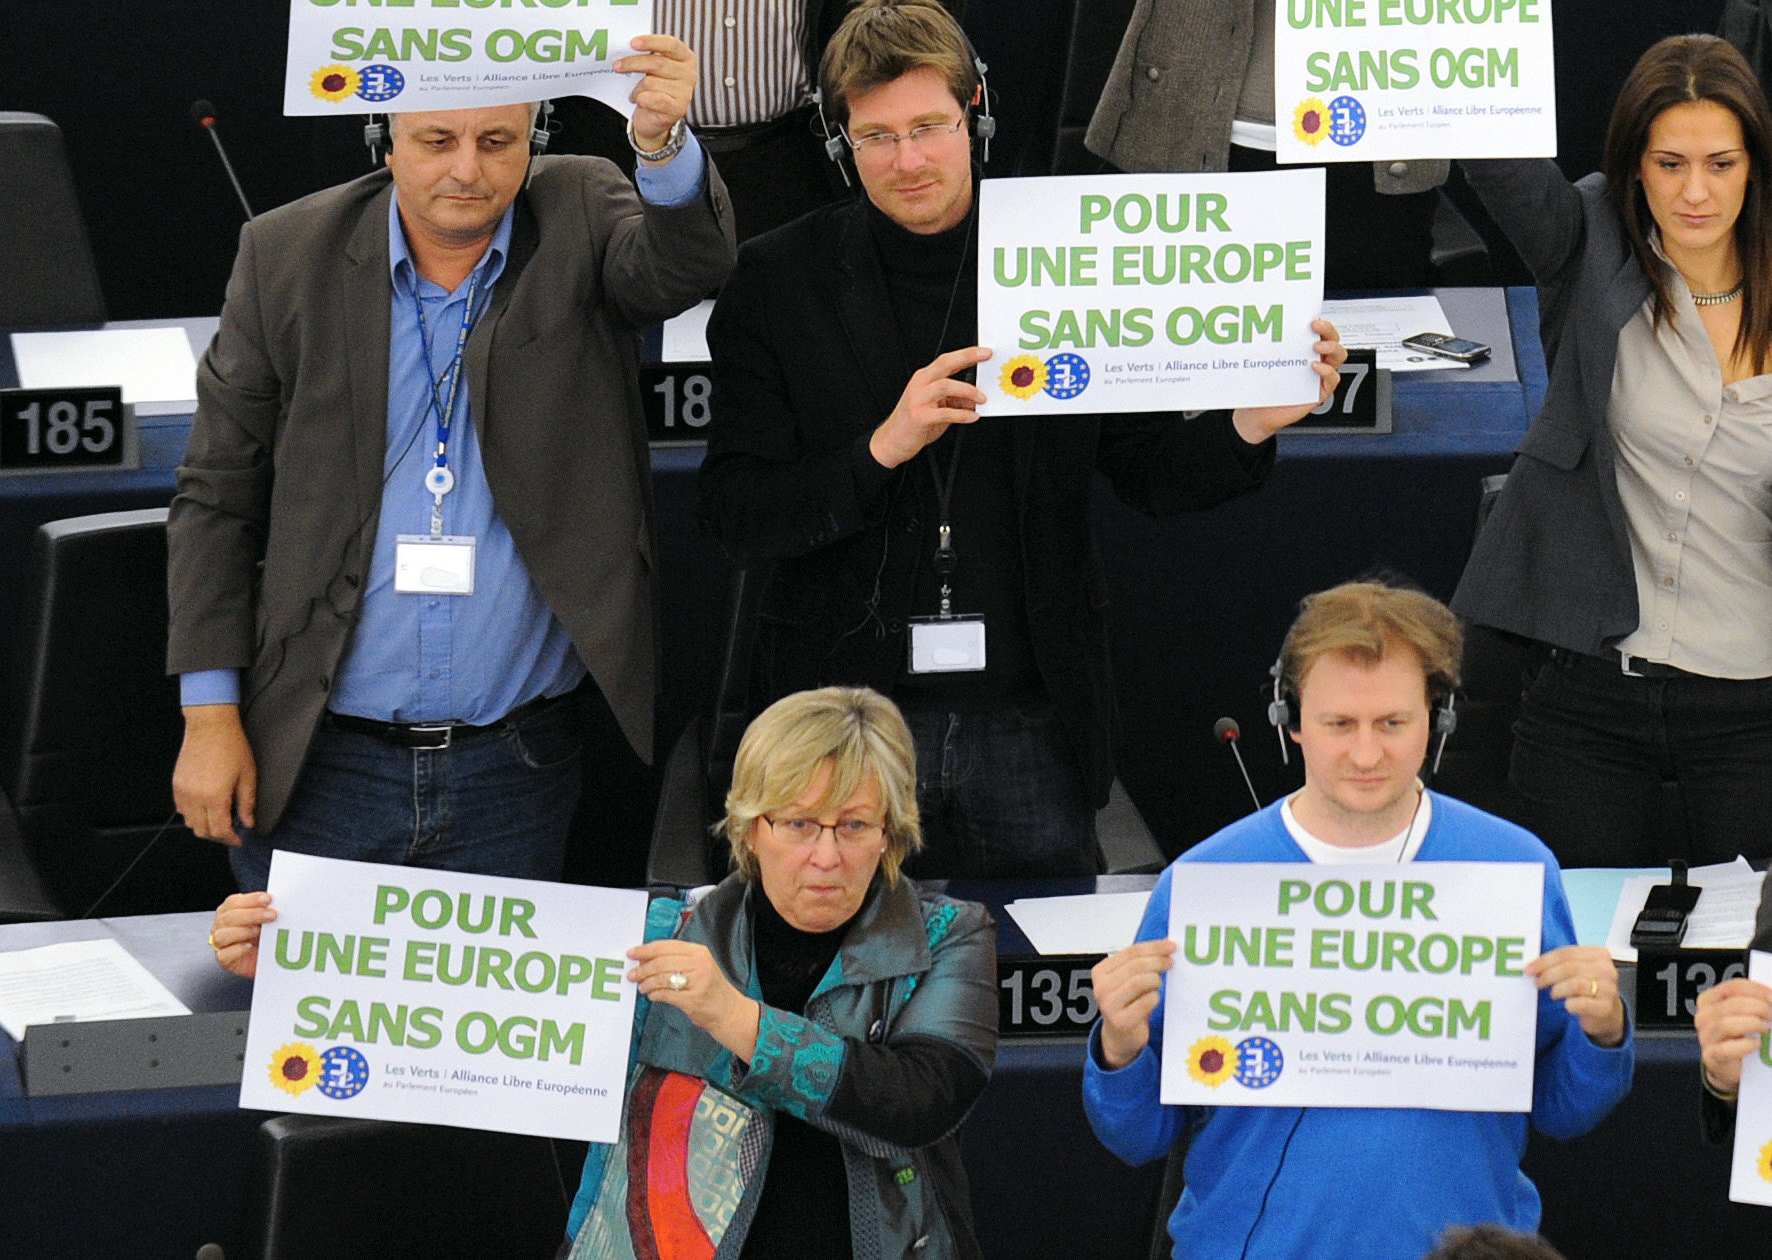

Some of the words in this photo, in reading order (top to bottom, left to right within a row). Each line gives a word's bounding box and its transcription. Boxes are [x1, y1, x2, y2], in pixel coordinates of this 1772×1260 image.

[332, 27, 472, 61] SANS
[486, 29, 609, 62] OGM
[1307, 49, 1420, 92] SANS
[1430, 48, 1519, 88] OGM
[1378, 107, 1394, 116] Les
[1398, 107, 1424, 116] Verts
[1432, 106, 1463, 115] Alliance
[1466, 106, 1486, 114] Libre
[1490, 105, 1541, 116] Européenne
[1081, 193, 1231, 233] POUR
[995, 246, 1097, 287] UNE
[1114, 241, 1311, 285] EUROPE
[1020, 308, 1153, 349] SANS
[1167, 304, 1284, 345] OGM
[1105, 363, 1122, 372] Les
[1127, 363, 1153, 372] Verts
[1165, 360, 1208, 370] Alliance
[1212, 360, 1239, 369] Libre
[1243, 358, 1307, 370] Européenne
[654, 375, 712, 427] 18
[19, 401, 114, 453] 185
[374, 886, 535, 937] POUR
[1279, 880, 1435, 919] POUR
[275, 929, 386, 977] UNE
[403, 941, 624, 1000] EUROPE
[1185, 926, 1294, 966] UNE
[1311, 929, 1525, 976] EUROPE
[1001, 971, 1098, 1024] 135
[1656, 962, 1745, 1016] 13
[295, 996, 443, 1048] SANS
[455, 1012, 586, 1064] OGM
[1209, 989, 1352, 1032] SANS
[1366, 995, 1491, 1038] OGM
[385, 1064, 405, 1075] Les
[409, 1066, 439, 1079] Verts
[451, 1069, 499, 1085] Alliance
[502, 1075, 533, 1089] Libre
[536, 1080, 609, 1100] Européenne
